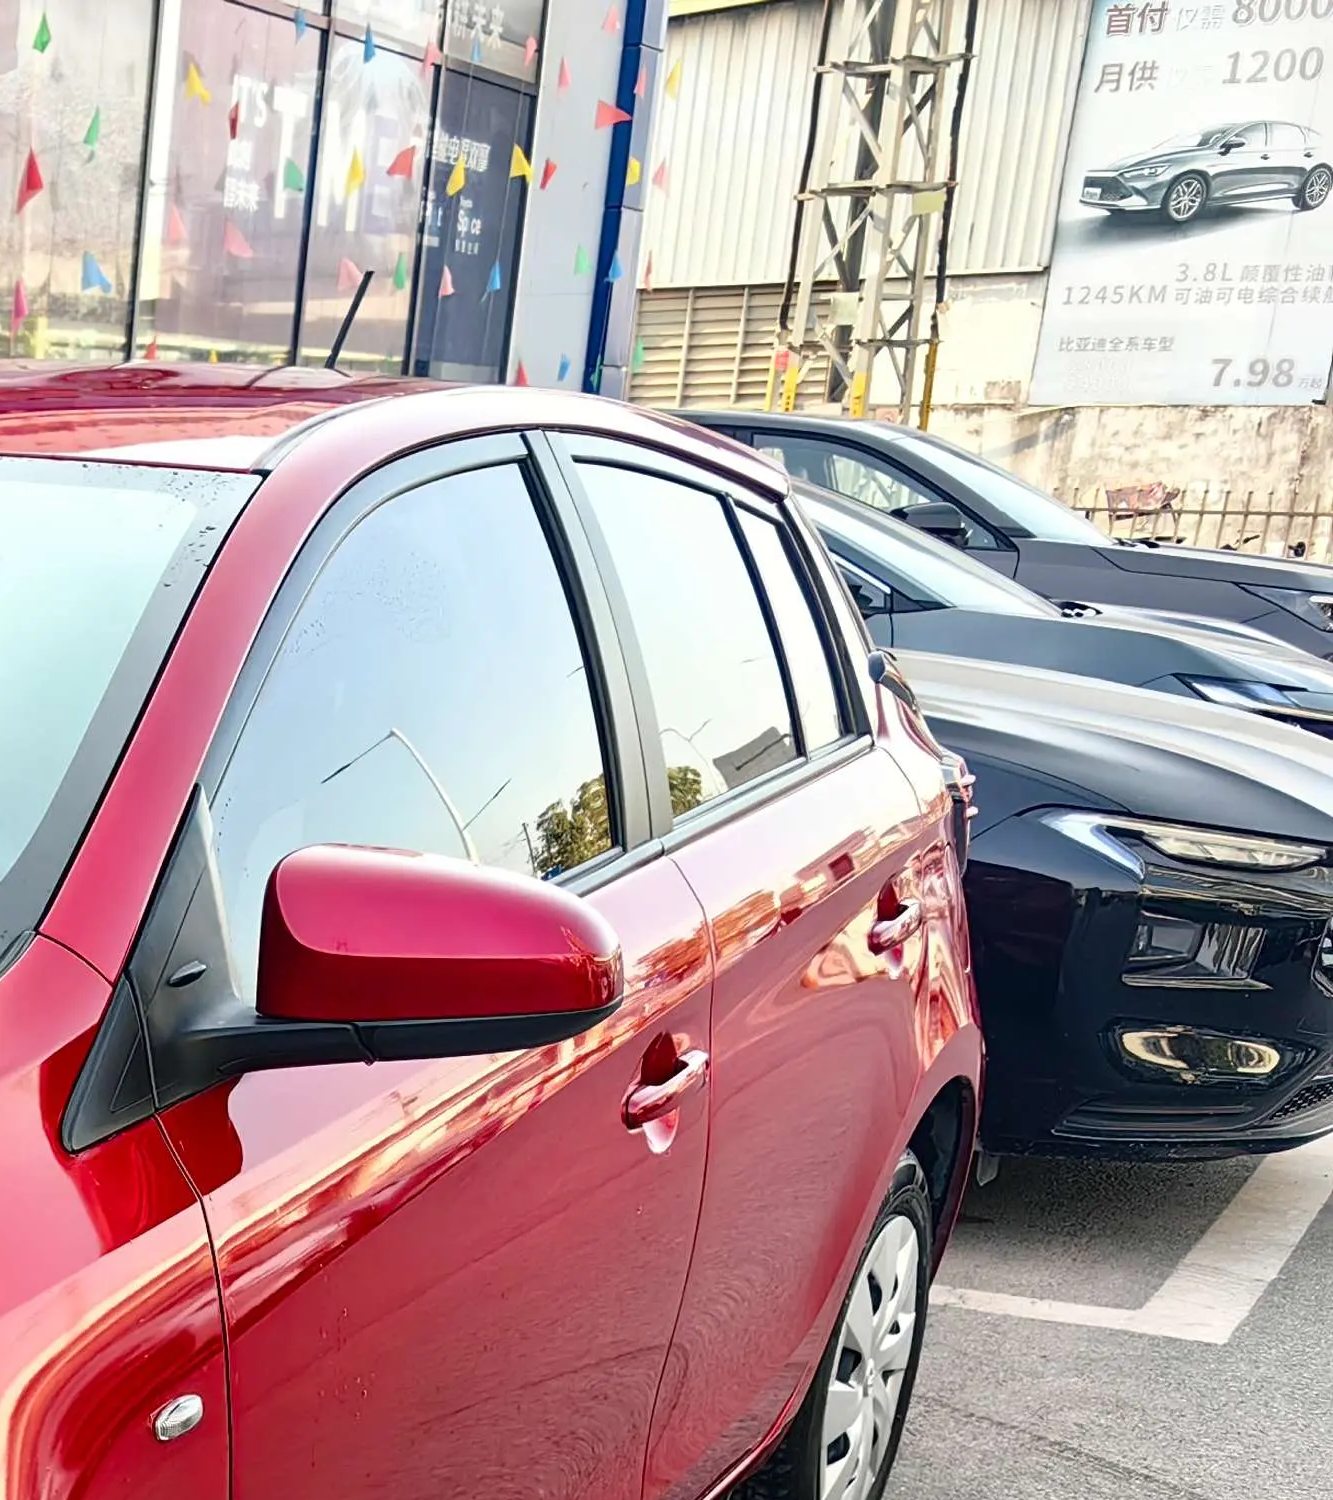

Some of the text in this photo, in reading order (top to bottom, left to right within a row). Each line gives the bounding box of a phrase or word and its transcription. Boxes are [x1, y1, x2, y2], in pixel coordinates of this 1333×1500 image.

[1106, 2, 1168, 36] 首付
[1094, 60, 1160, 93] 月供
[1222, 47, 1325, 84] 1200
[1176, 263, 1233, 283] 3.8L
[1062, 284, 1169, 306] 1245KM
[1058, 337, 1175, 352] 比亚迪全系车型
[1210, 358, 1295, 388] 7.98
